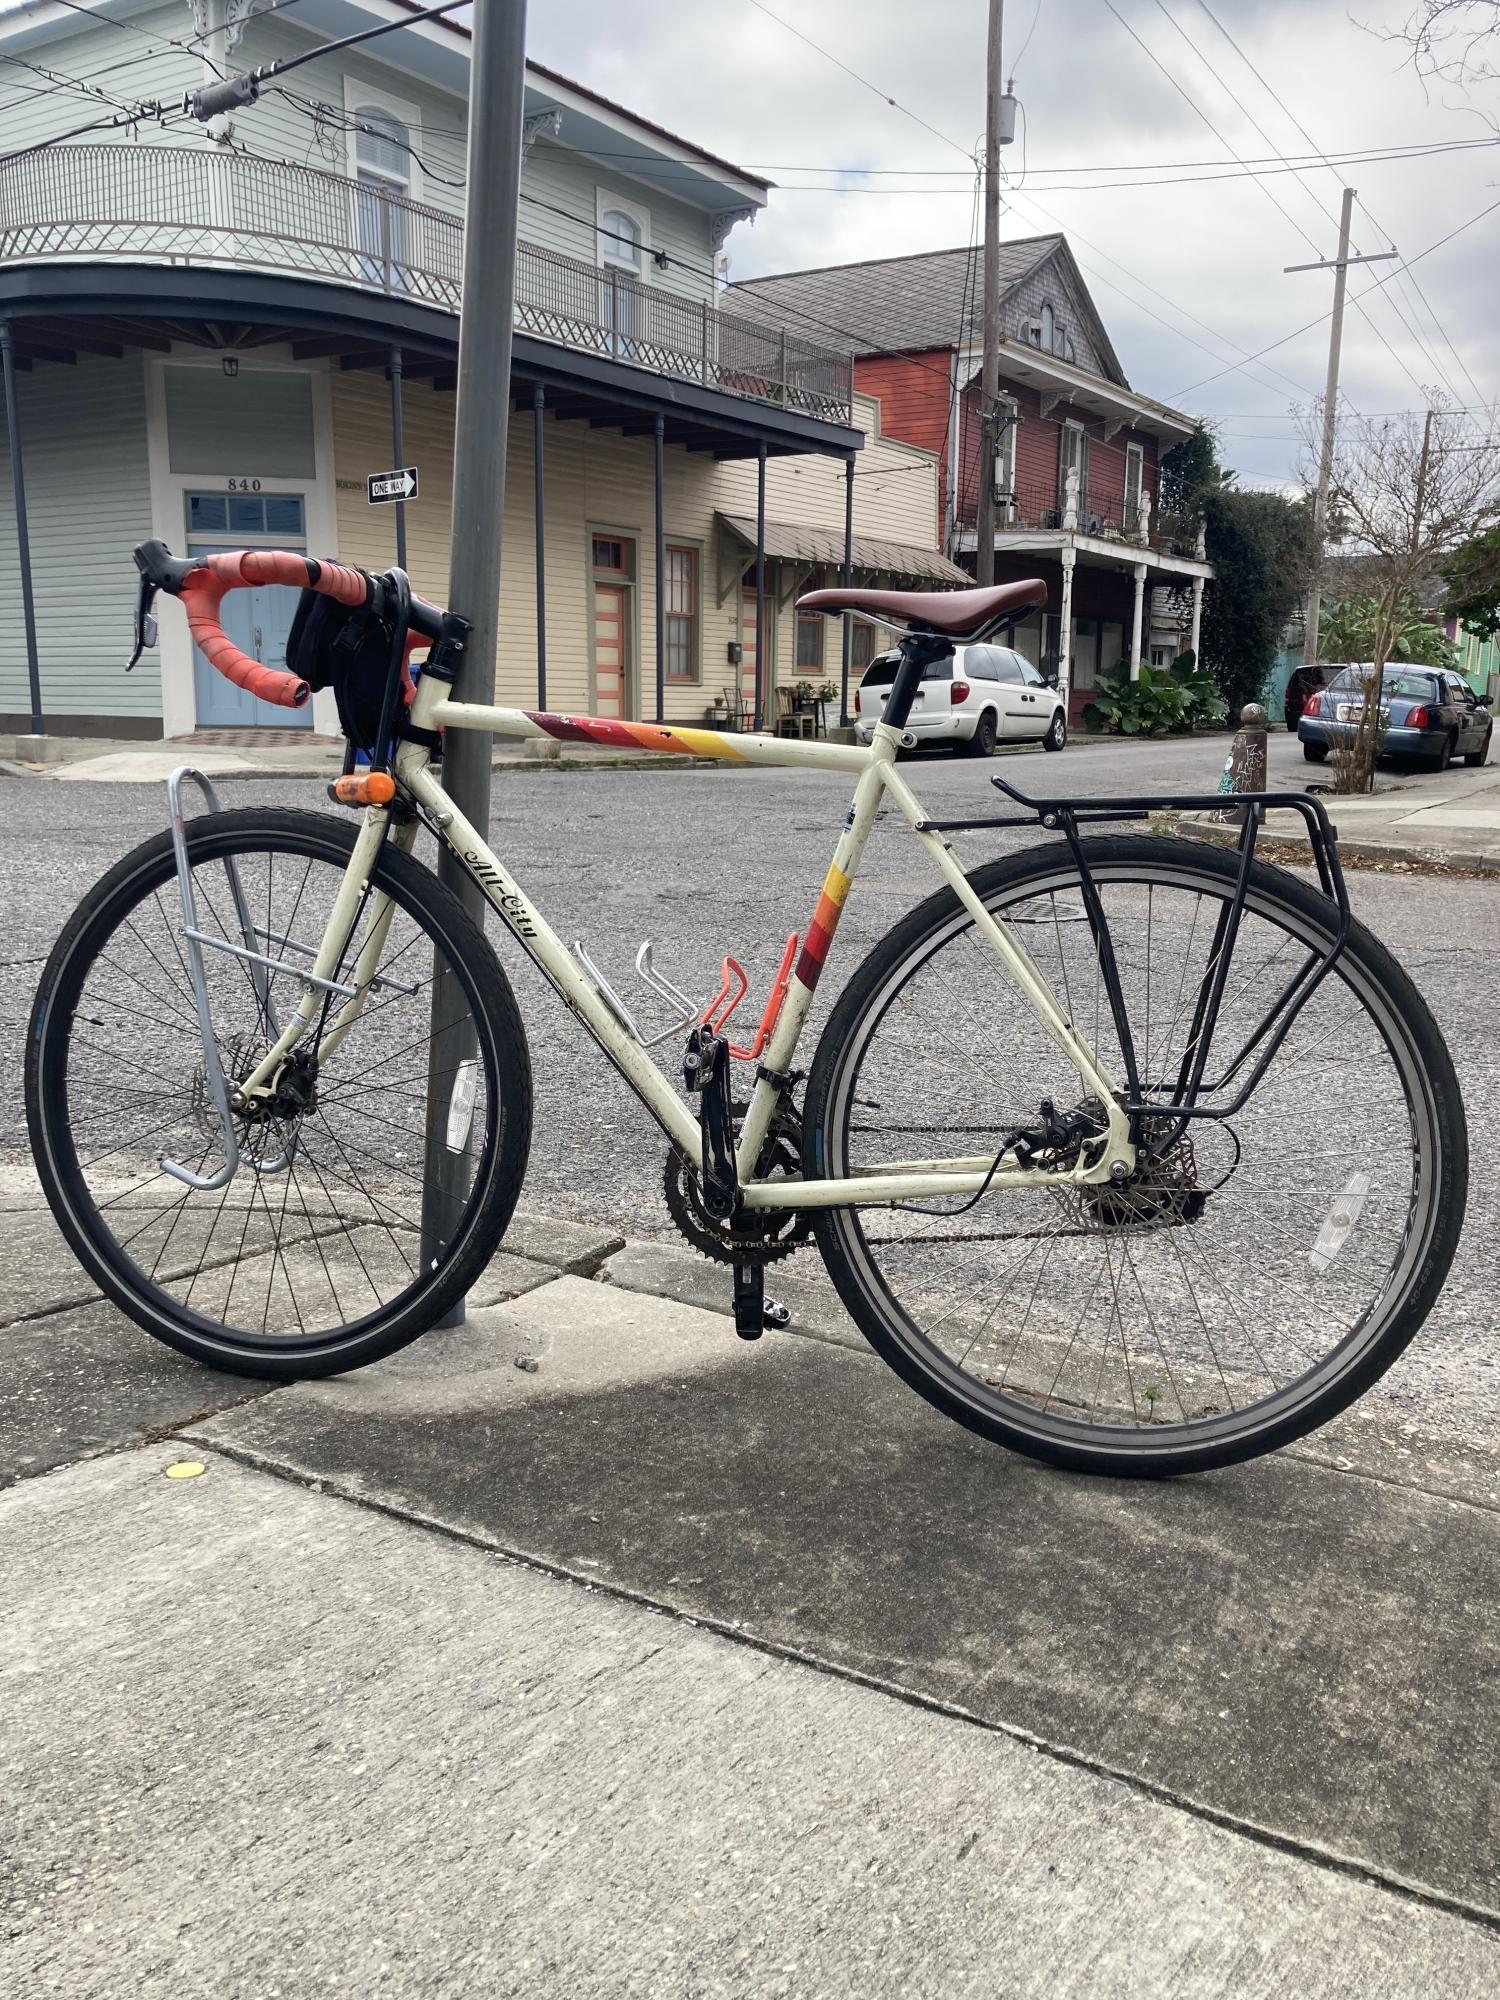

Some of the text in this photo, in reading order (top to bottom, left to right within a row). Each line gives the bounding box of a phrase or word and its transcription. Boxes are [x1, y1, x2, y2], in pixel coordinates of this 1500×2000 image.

[228, 478, 261, 491] 840
[374, 482, 389, 495] ONE
[390, 479, 404, 492] WAY
[464, 851, 537, 938] All-City
